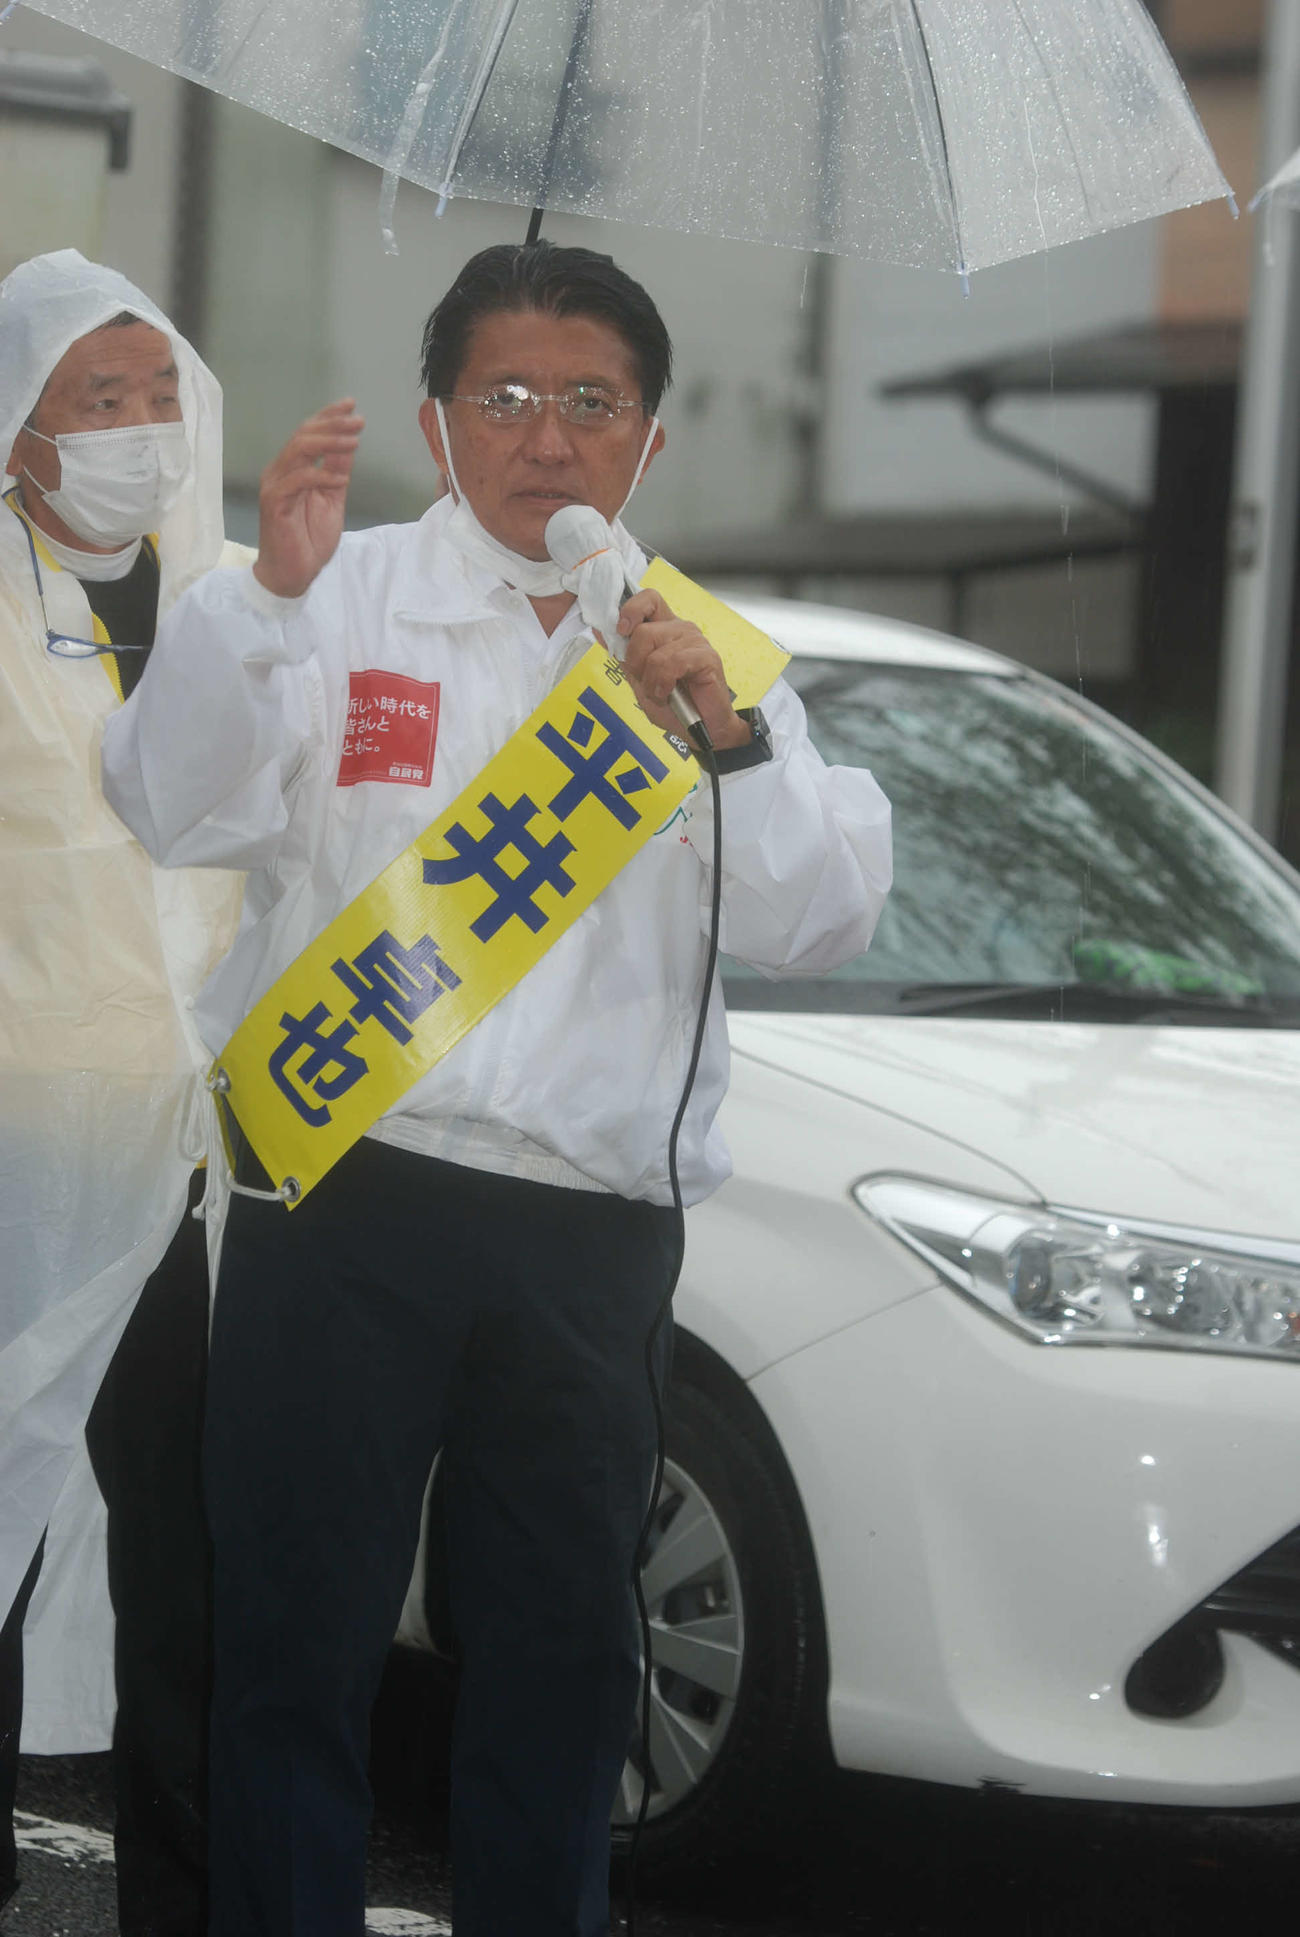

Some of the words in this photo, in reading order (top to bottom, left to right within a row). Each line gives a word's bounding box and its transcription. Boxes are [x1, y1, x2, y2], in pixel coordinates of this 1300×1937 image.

[388, 766, 424, 780] 自民党
[268, 686, 670, 1128] 平井卓也
